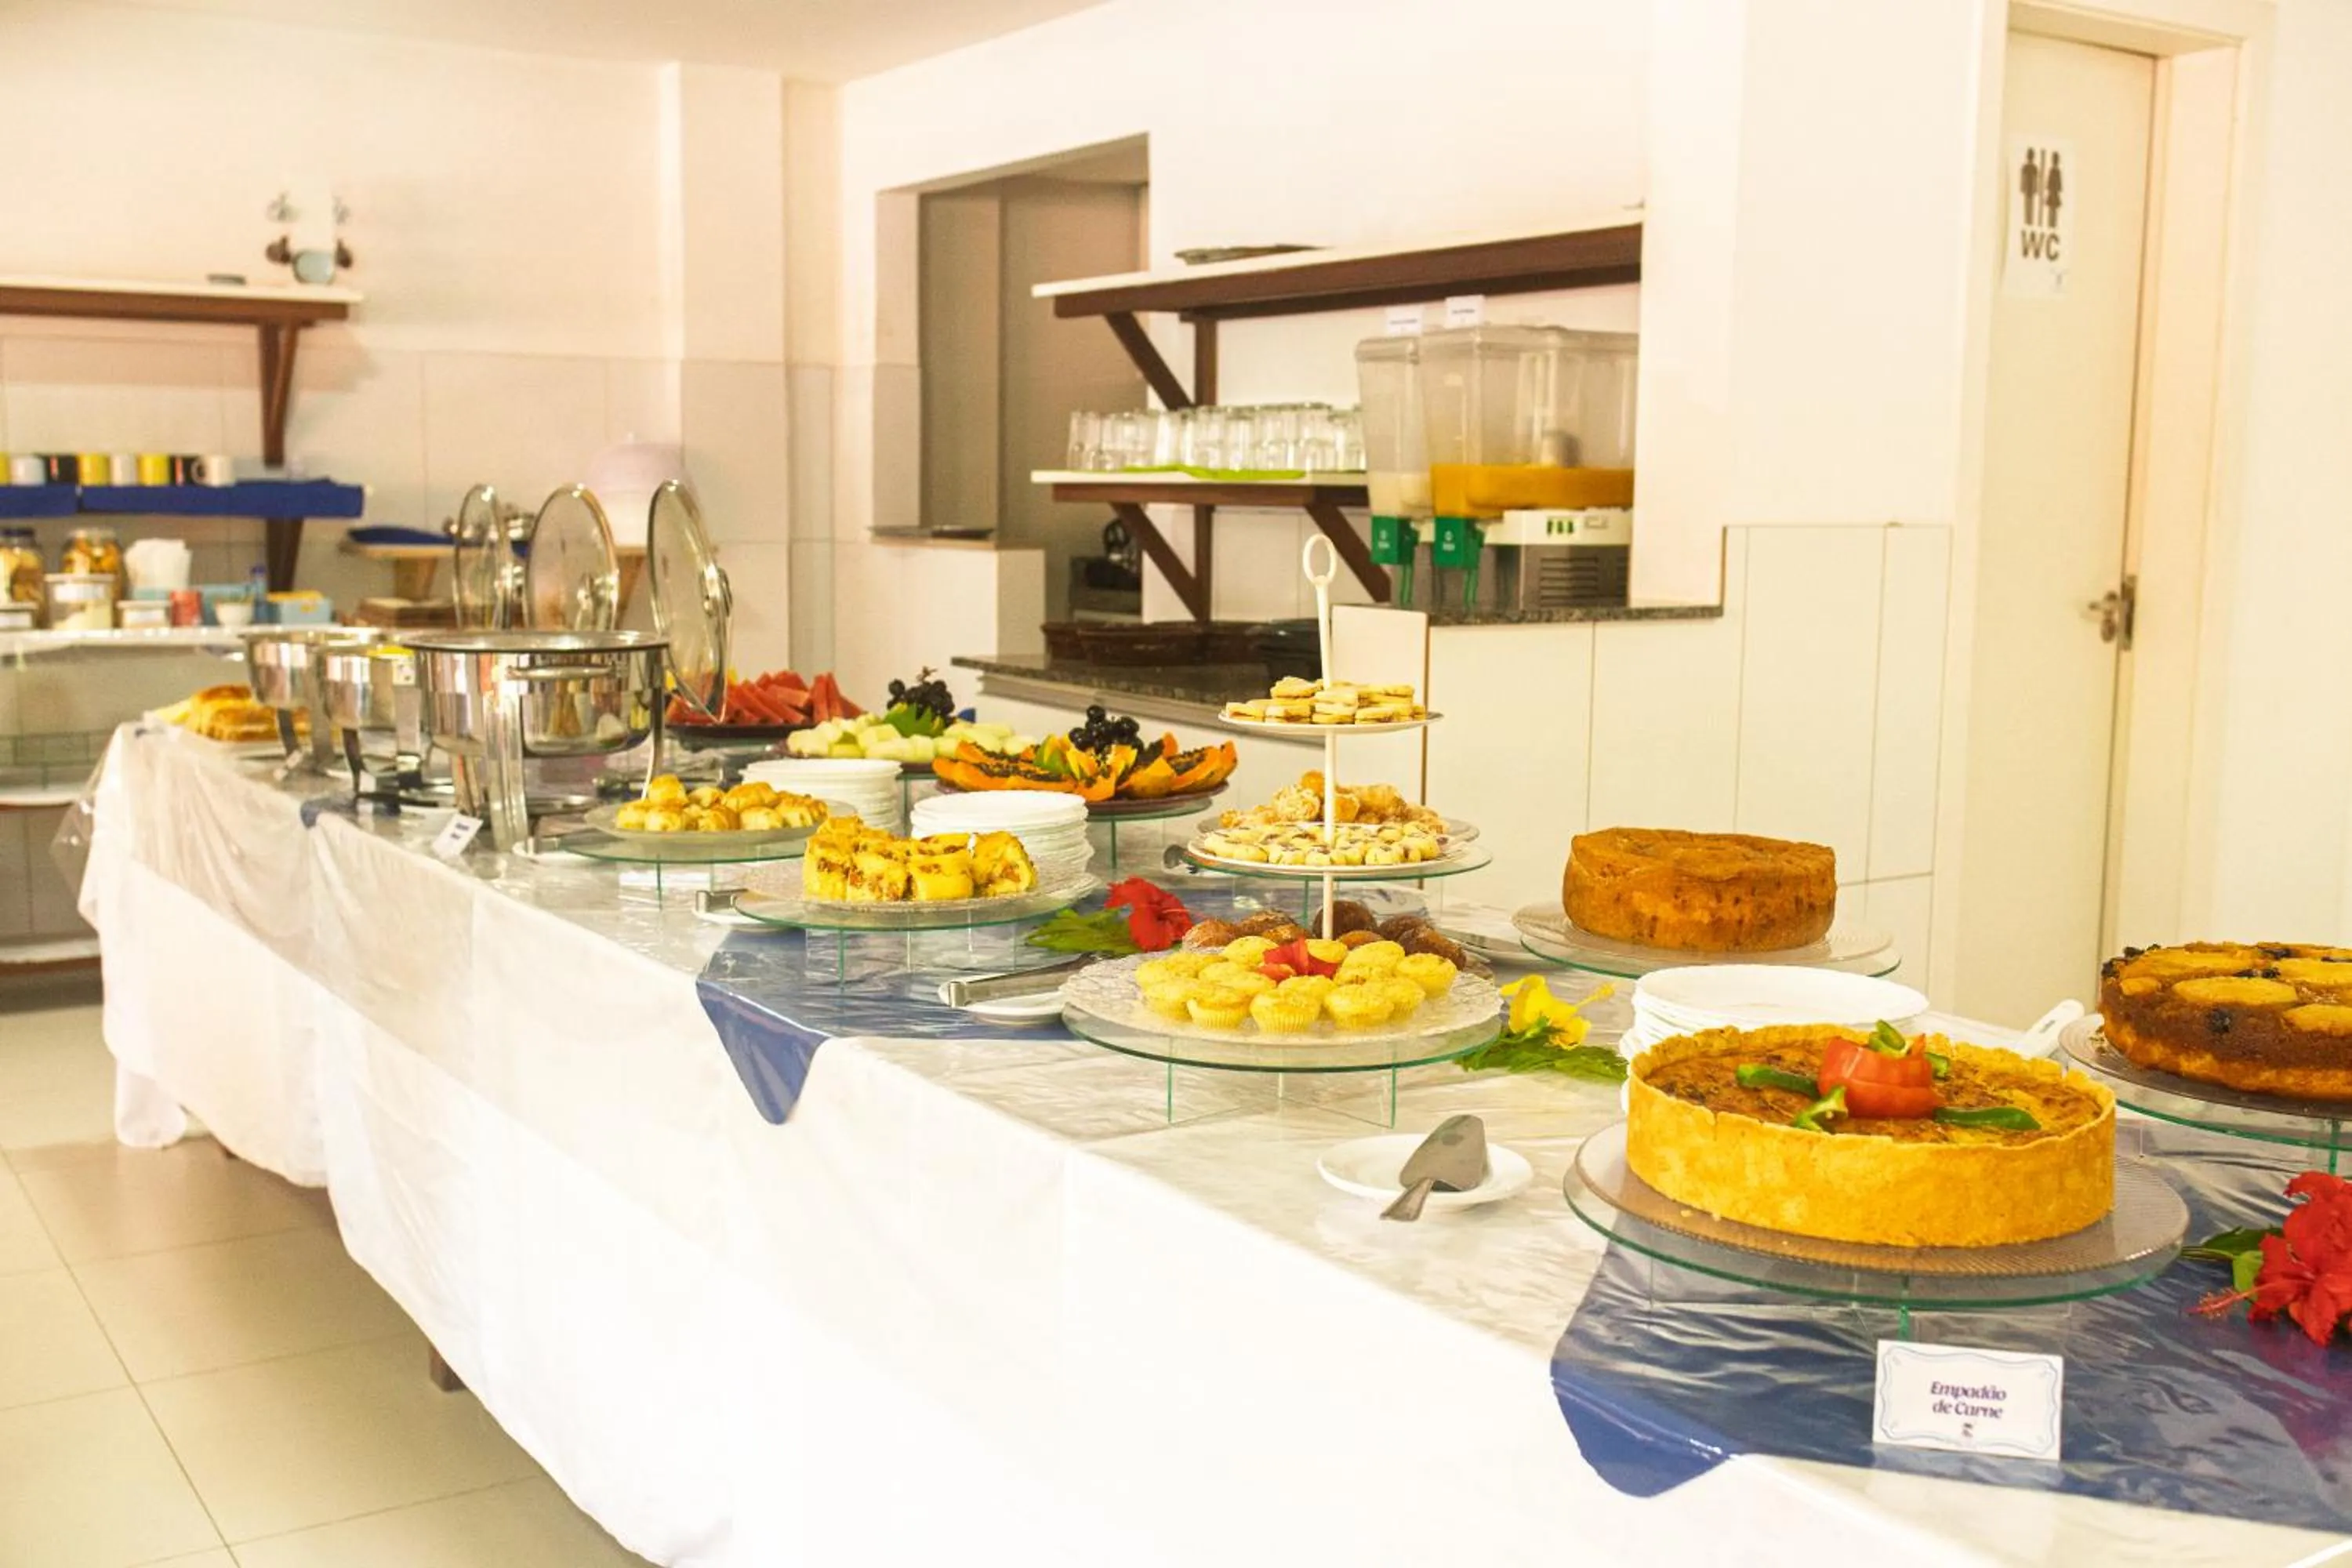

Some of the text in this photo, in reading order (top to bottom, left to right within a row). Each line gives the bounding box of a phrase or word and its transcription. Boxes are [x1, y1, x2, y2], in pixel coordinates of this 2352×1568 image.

[2021, 230, 2060, 261] WC
[1931, 1381, 2007, 1401] Empadão
[1933, 1399, 2003, 1418] de Carne
